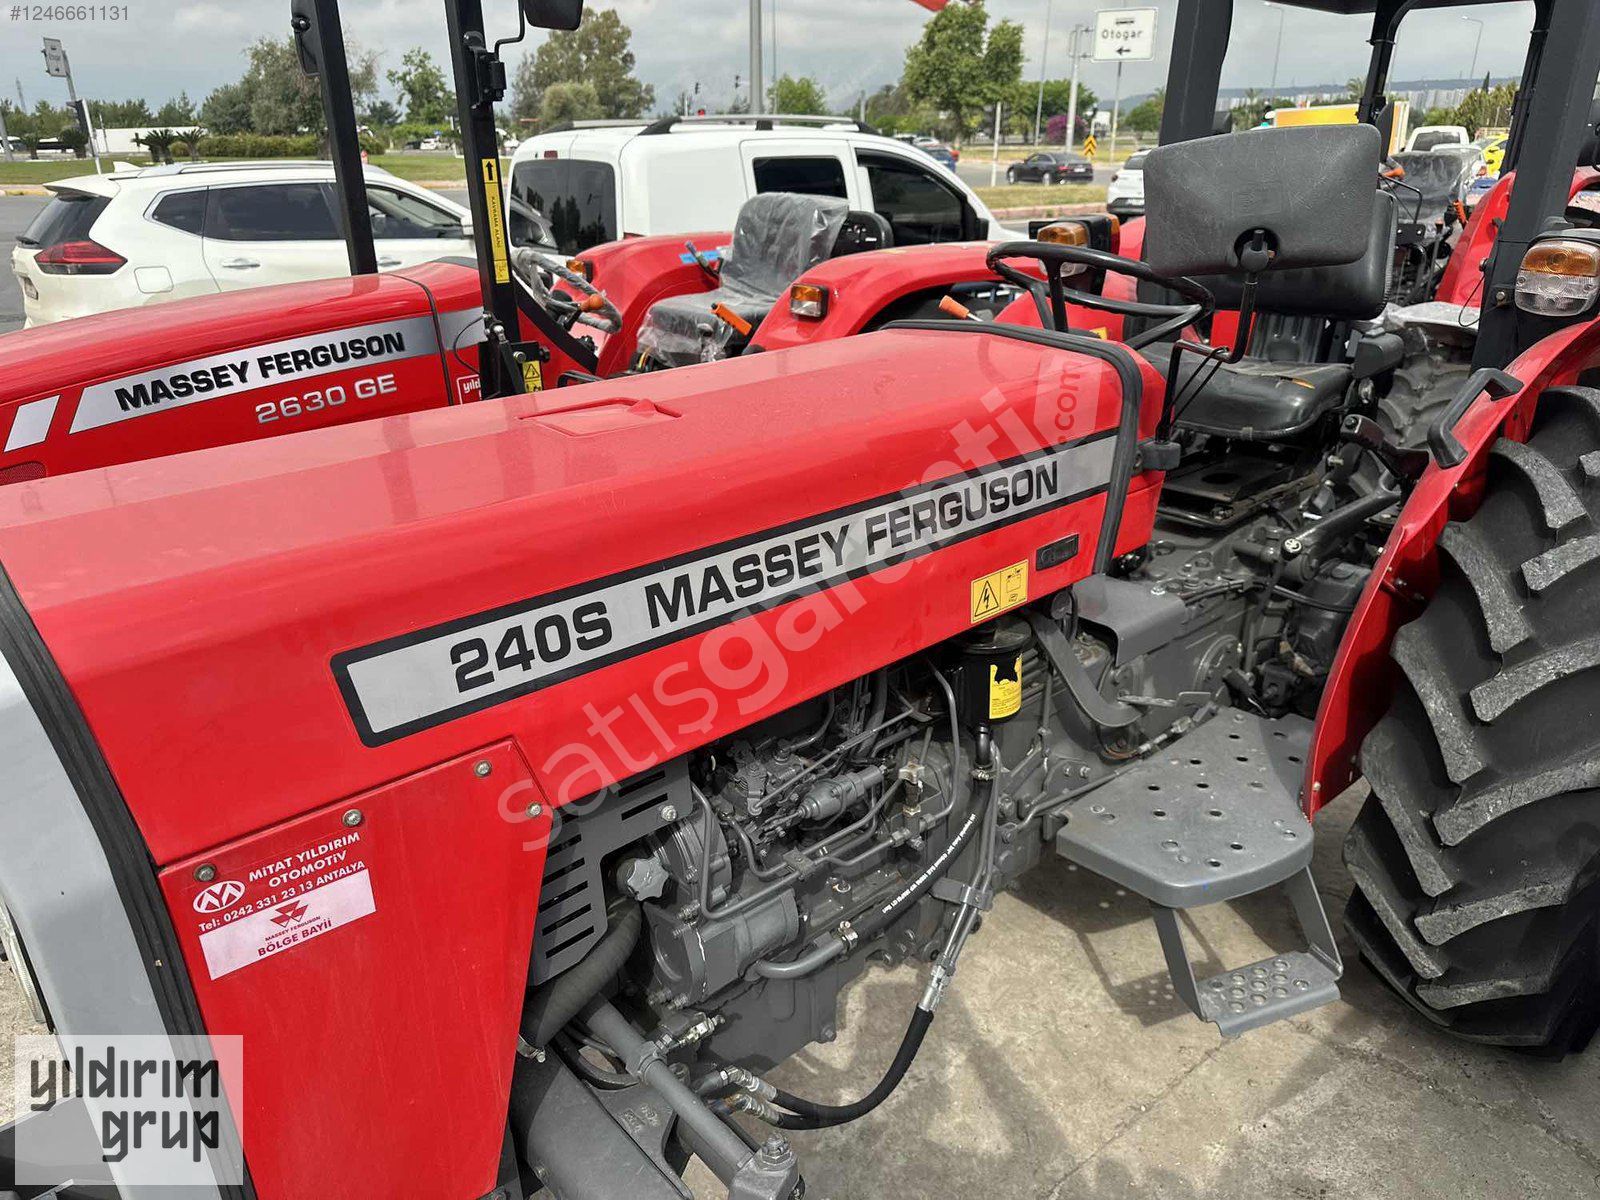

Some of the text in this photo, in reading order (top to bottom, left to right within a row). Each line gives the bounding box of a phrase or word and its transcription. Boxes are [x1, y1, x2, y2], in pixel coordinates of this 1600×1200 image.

[1101, 29, 1143, 41] Otogar
[114, 331, 406, 412] MASSEY FERGUSON
[254, 373, 398, 424] 2630 GE
[449, 460, 1058, 694] 240S MASSEY FERGUSON
[296, 832, 361, 863] YILDIRIM
[198, 861, 365, 932] Tel: 0242 331 23 13 ANTALYA
[257, 933, 299, 957] BÖLGE
[265, 929, 290, 941] MASSEY
